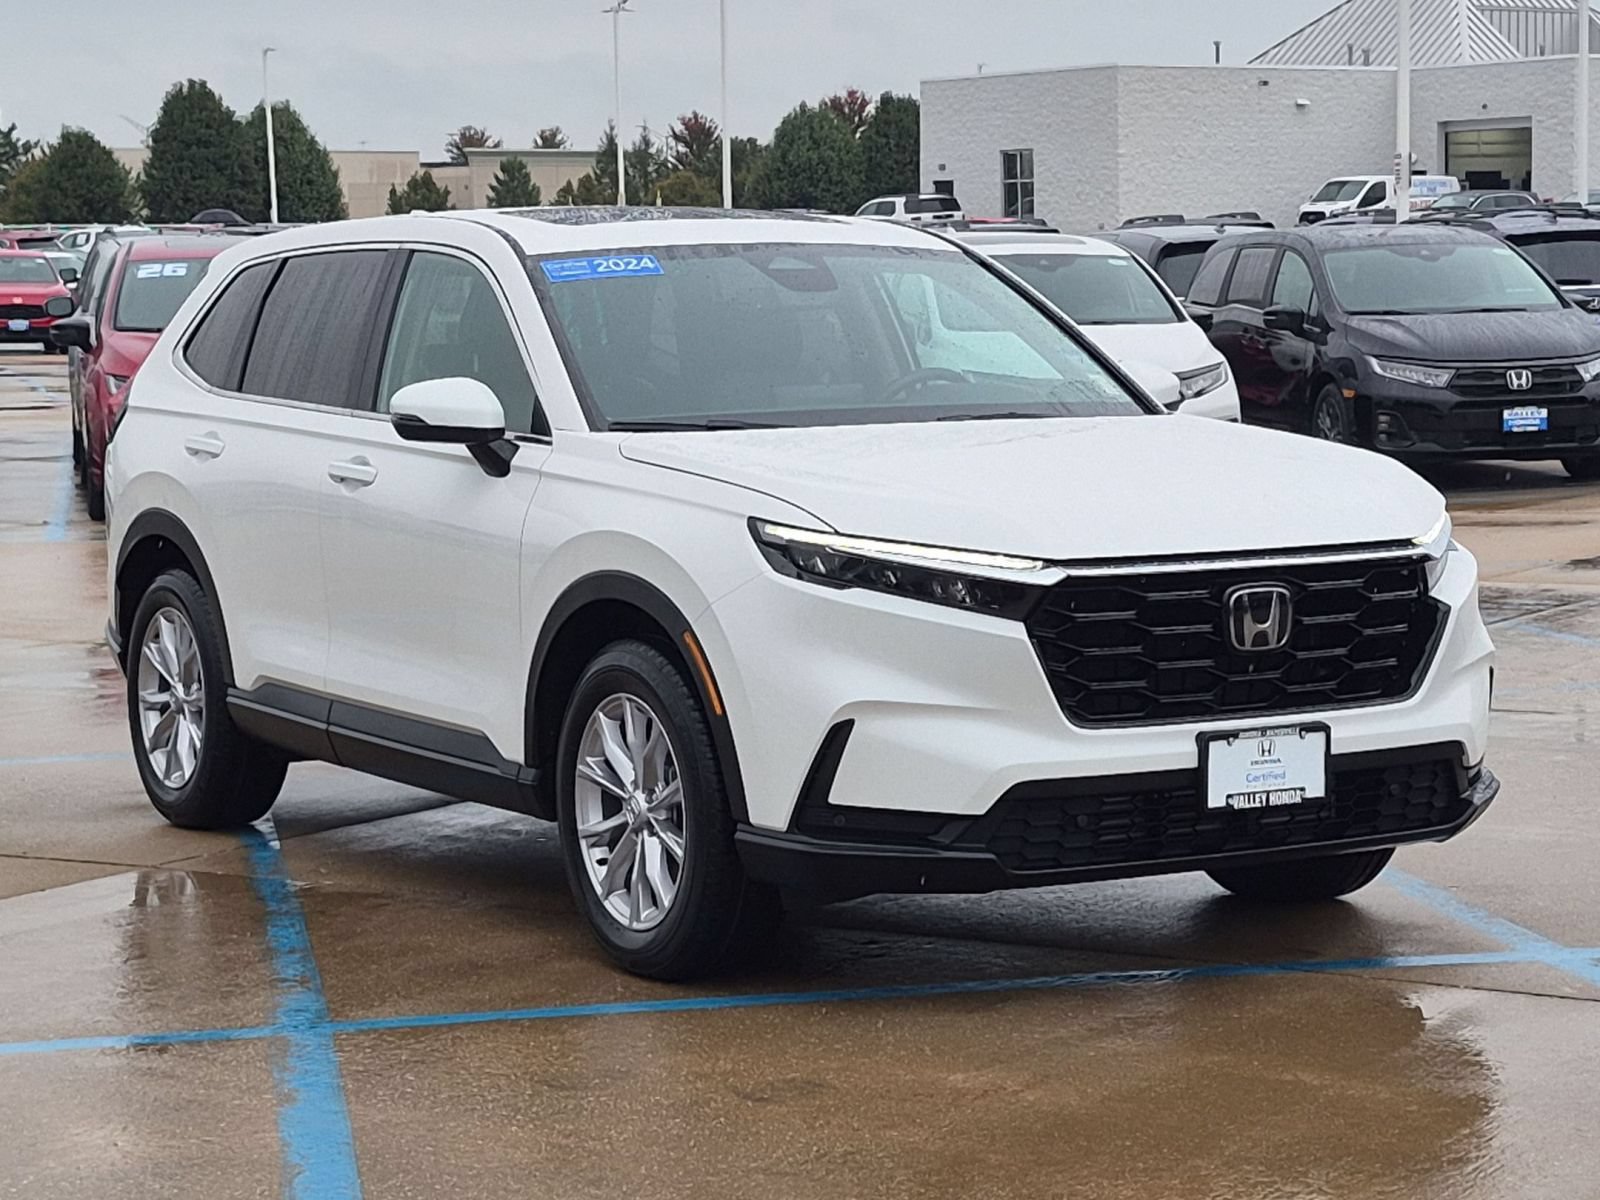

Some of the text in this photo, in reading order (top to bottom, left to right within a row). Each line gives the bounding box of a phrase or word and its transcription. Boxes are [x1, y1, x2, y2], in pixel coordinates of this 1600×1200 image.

[136, 262, 188, 279] 26
[593, 257, 654, 272] 2024
[1246, 771, 1286, 783] Certified
[1233, 789, 1302, 809] VALLEY HONDA
